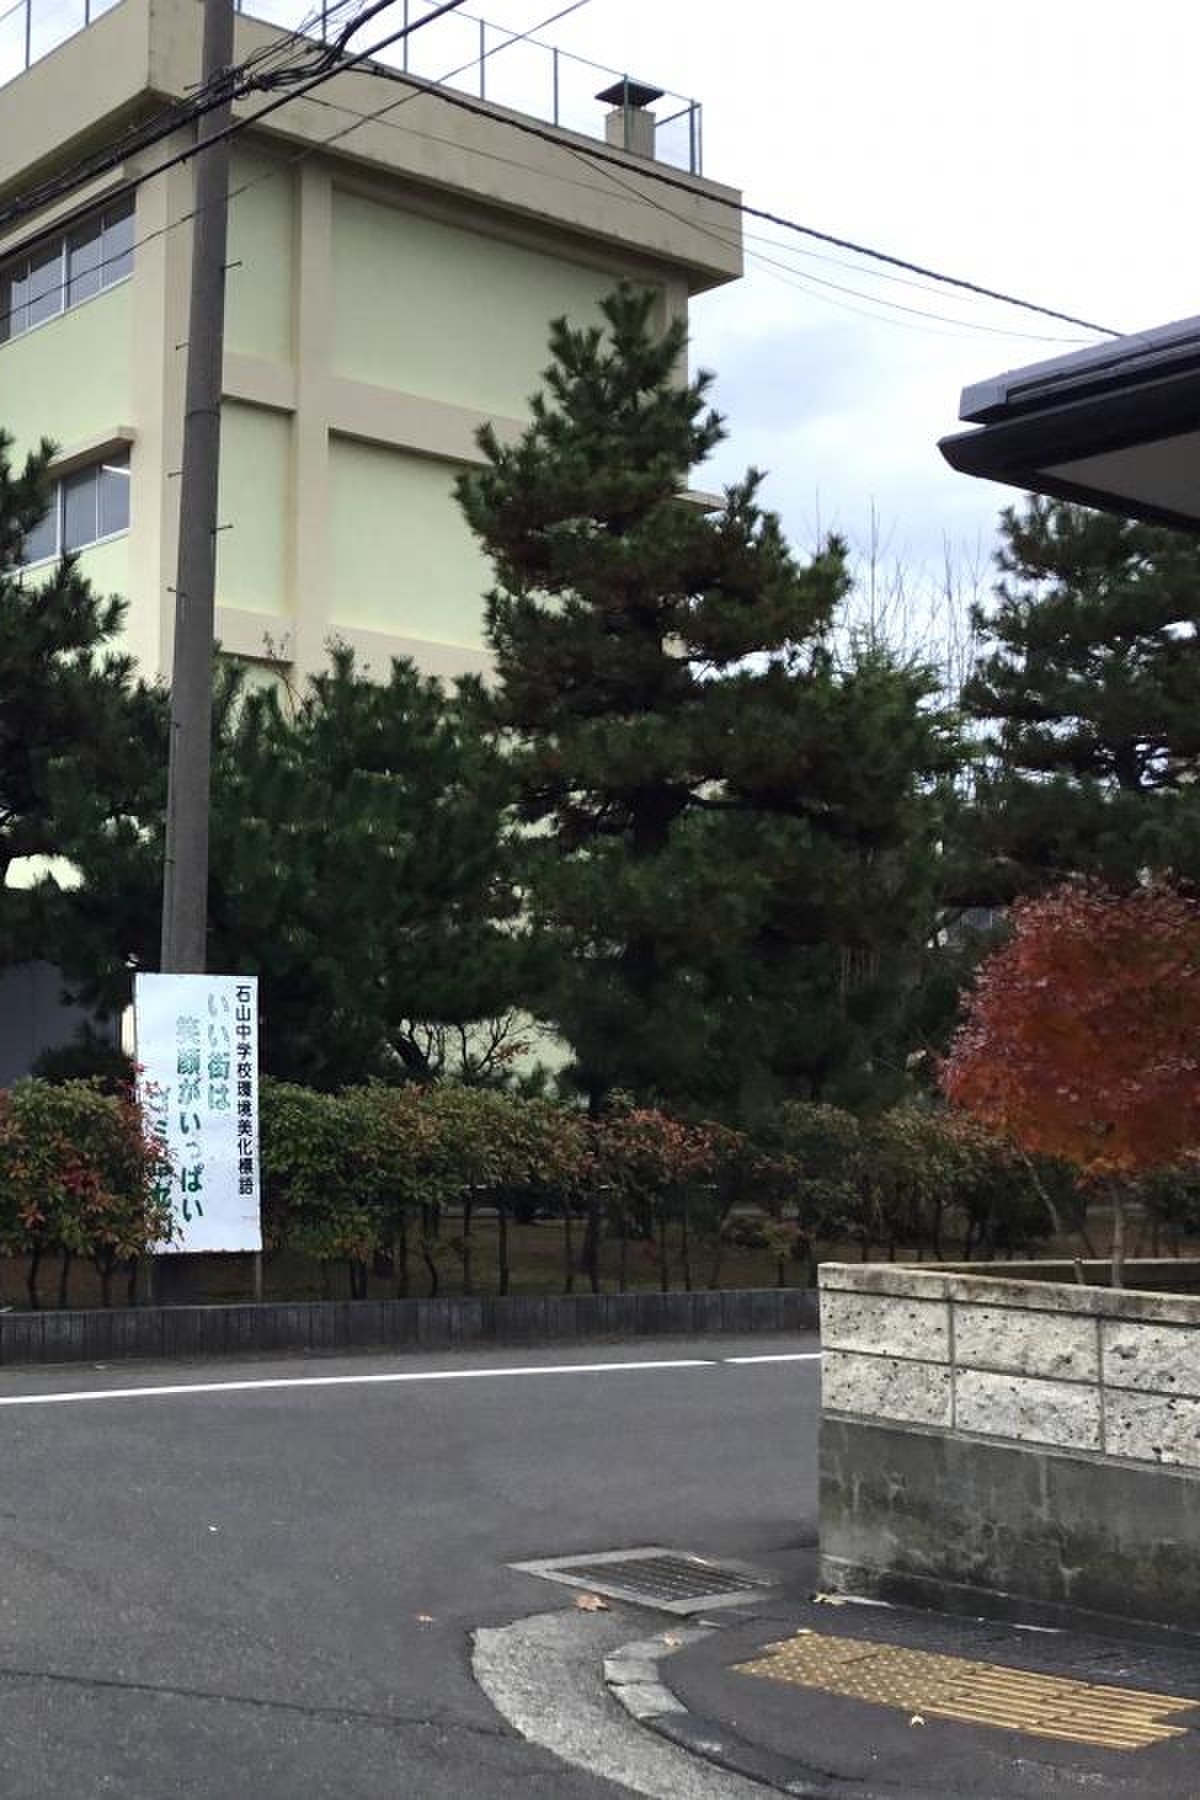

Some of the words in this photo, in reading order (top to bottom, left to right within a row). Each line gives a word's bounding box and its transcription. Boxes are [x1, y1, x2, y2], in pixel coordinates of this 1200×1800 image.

[207, 993, 231, 1111] いい街は
[236, 985, 254, 1196] 石山中学校環境美化標語
